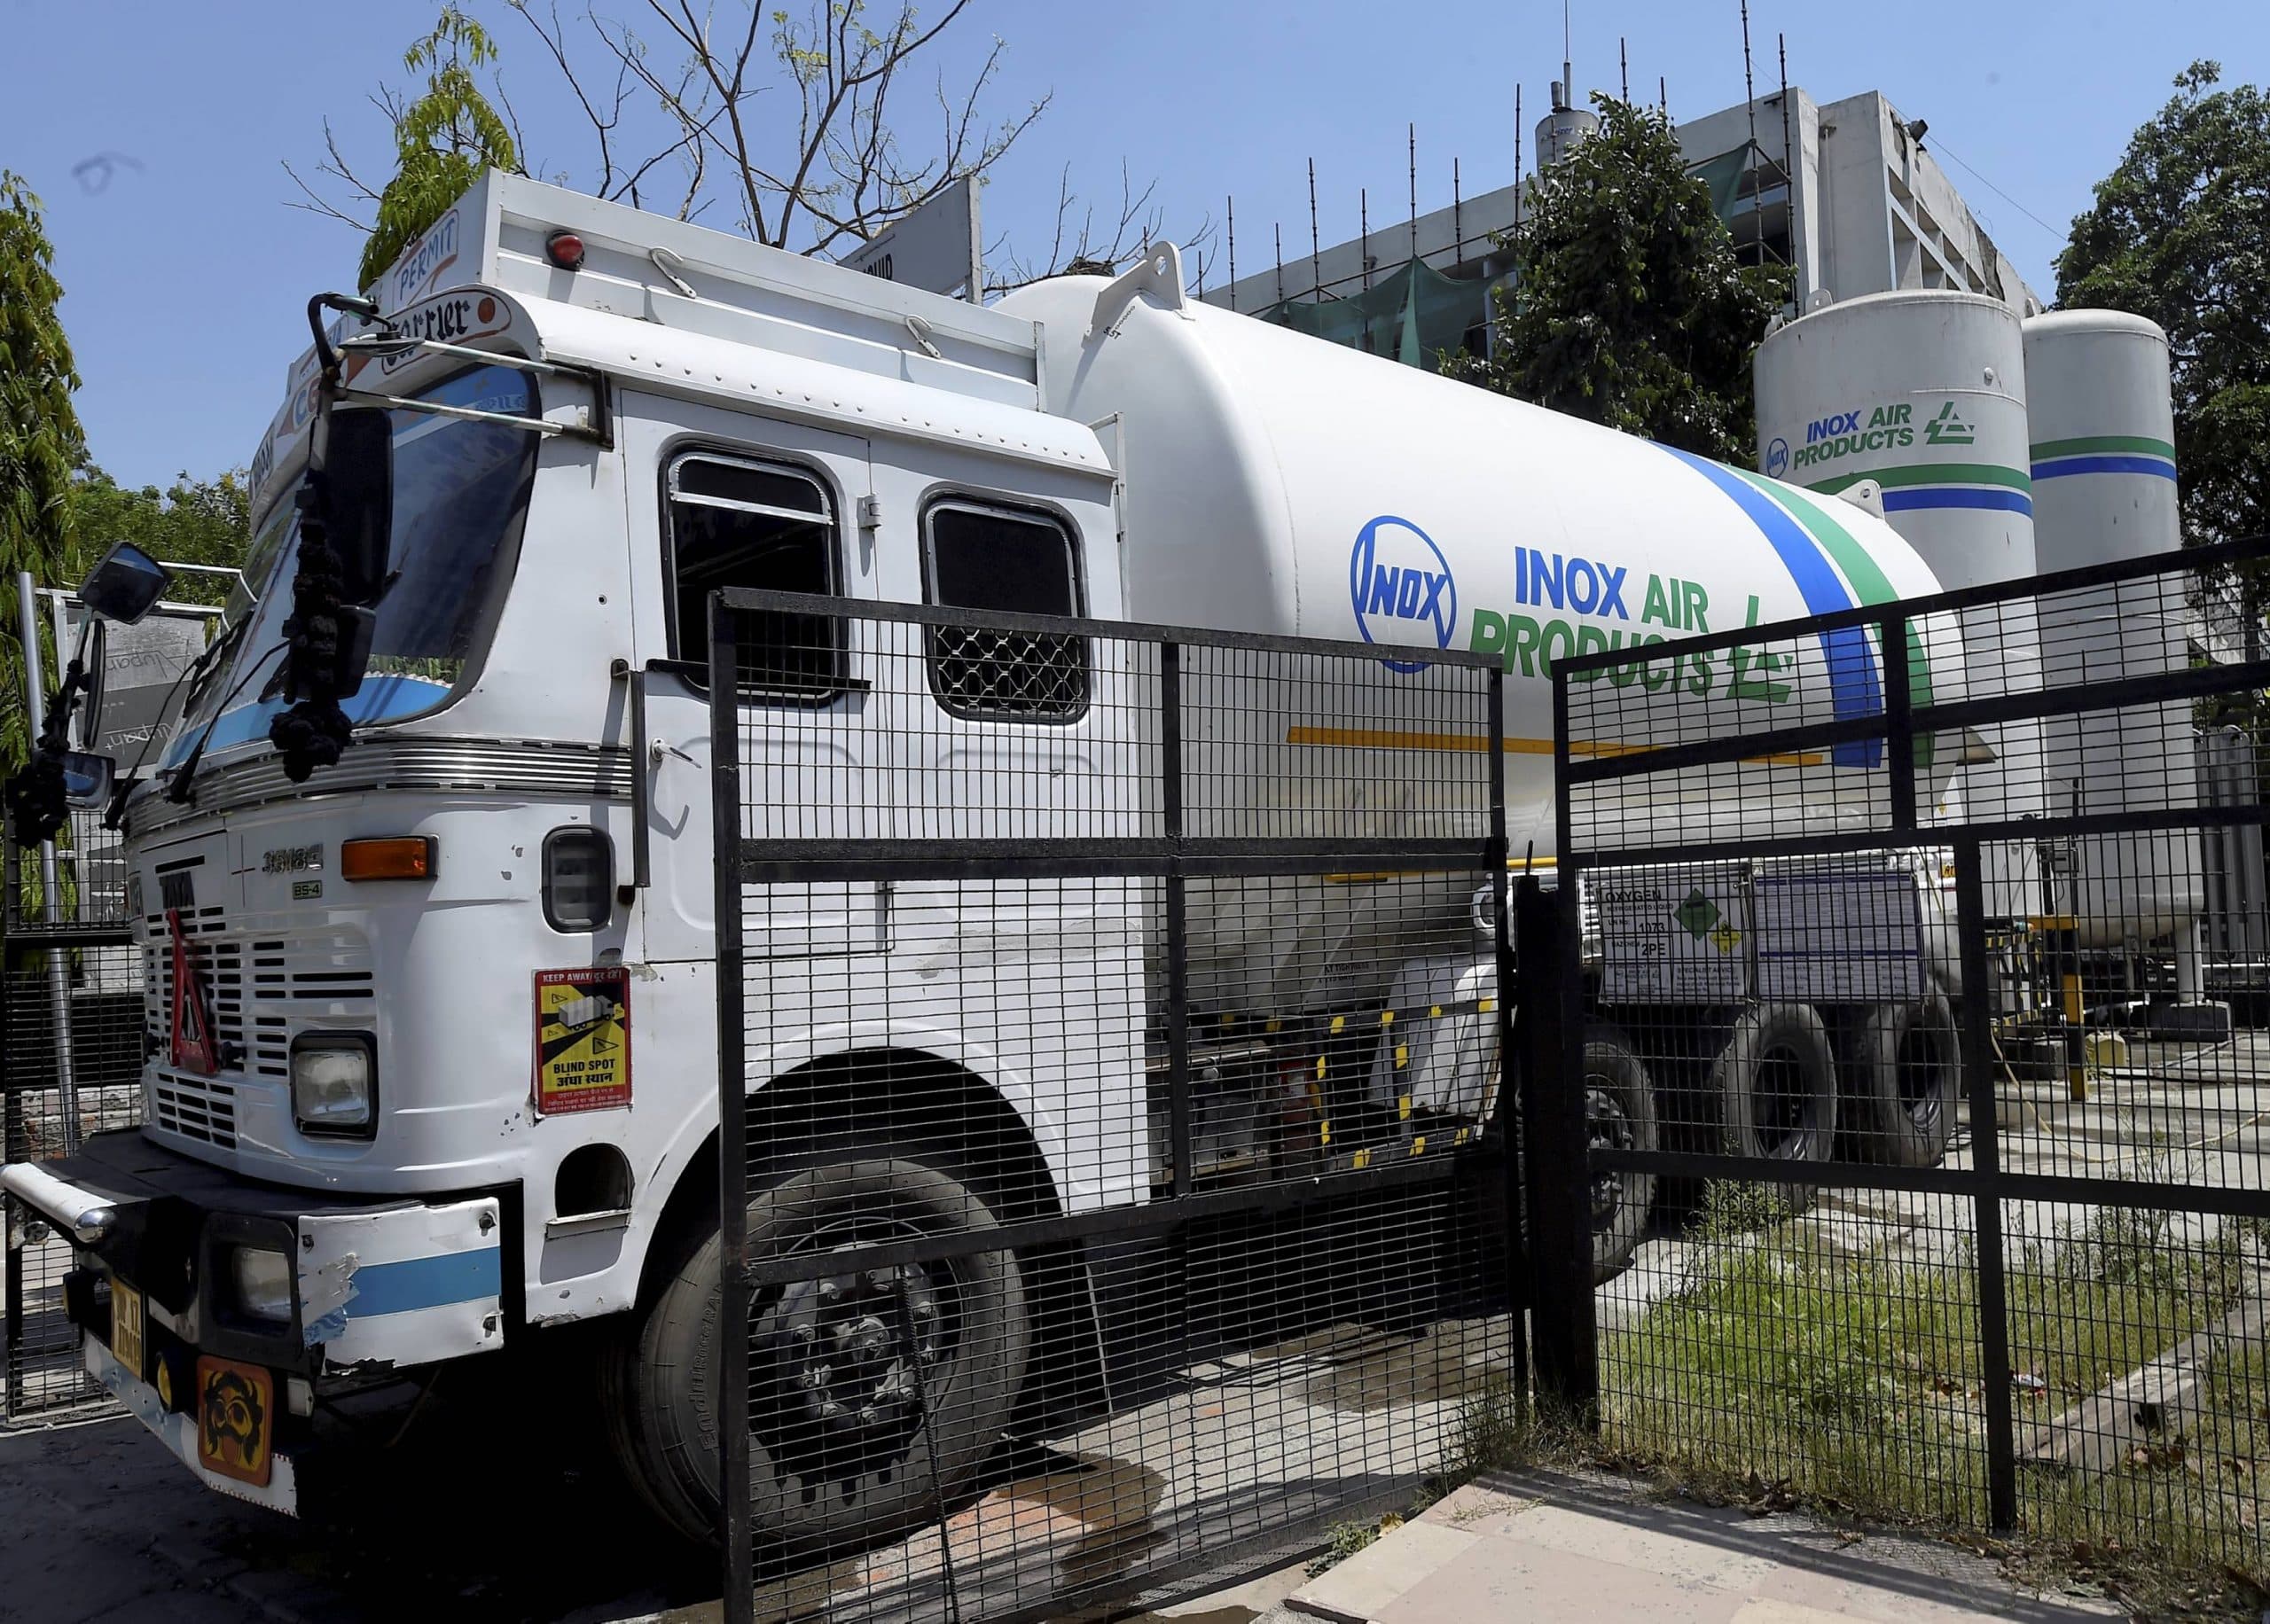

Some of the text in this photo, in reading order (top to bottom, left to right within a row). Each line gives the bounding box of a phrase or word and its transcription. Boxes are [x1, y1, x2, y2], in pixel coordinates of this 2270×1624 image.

[399, 217, 456, 301] PERMIT
[1806, 403, 1913, 443] INOX AIR
[1794, 427, 1914, 470] PRODUCTS
[1357, 521, 1451, 650] INOX
[1515, 546, 1709, 633] INOX AIR
[1468, 608, 1717, 697] PRODUCTS
[294, 884, 320, 896] BS-4
[1606, 889, 1661, 902] OXYGEN
[543, 973, 565, 982] KEEP
[553, 1058, 616, 1074] BLIND SPOT
